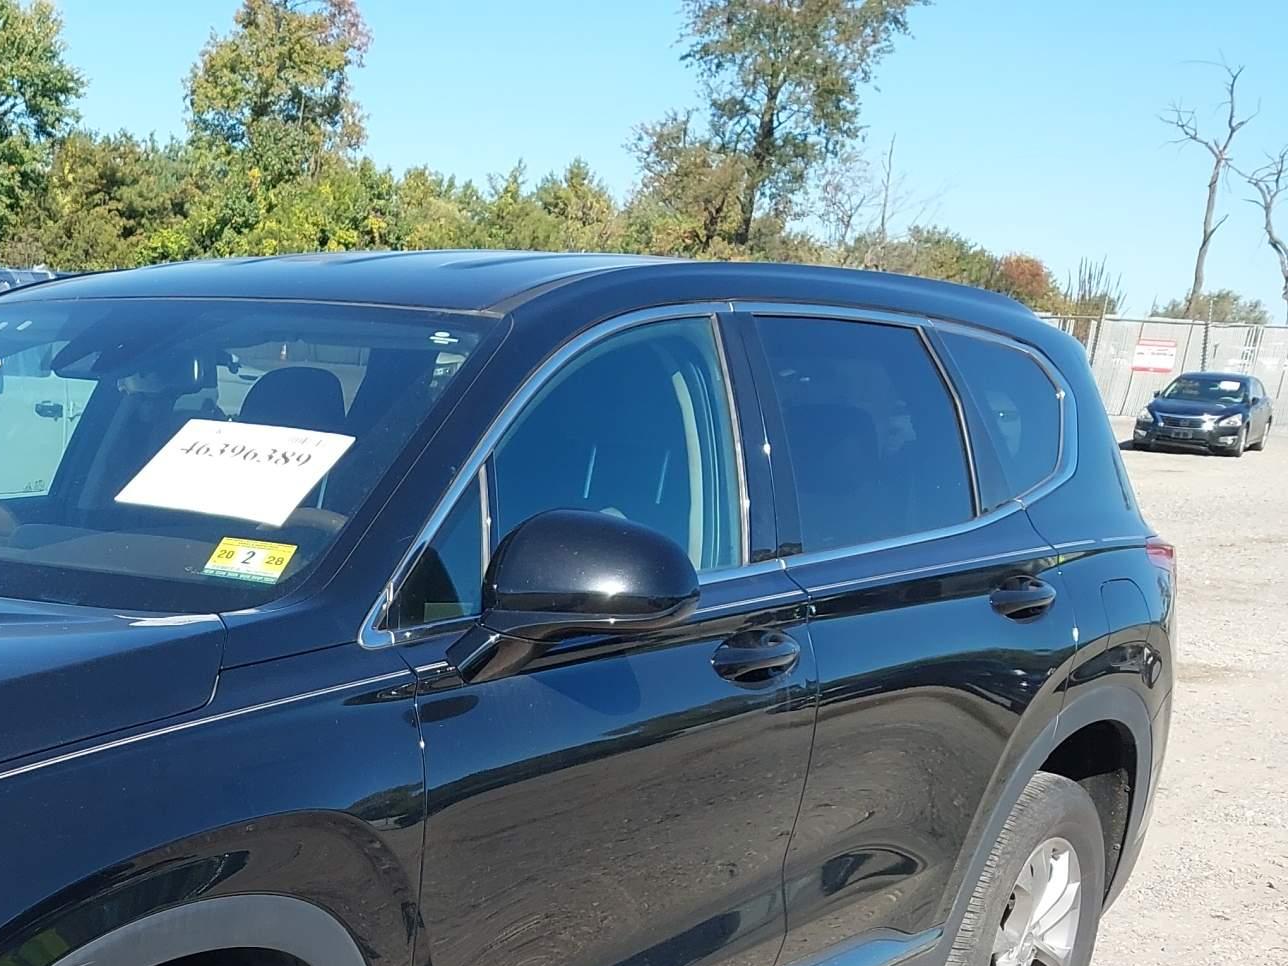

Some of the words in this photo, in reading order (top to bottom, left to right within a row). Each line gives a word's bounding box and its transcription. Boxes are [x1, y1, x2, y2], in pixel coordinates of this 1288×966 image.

[181, 441, 312, 466] 46396389
[217, 549, 236, 560] 20
[240, 550, 257, 565] 2
[265, 556, 286, 566] 28
